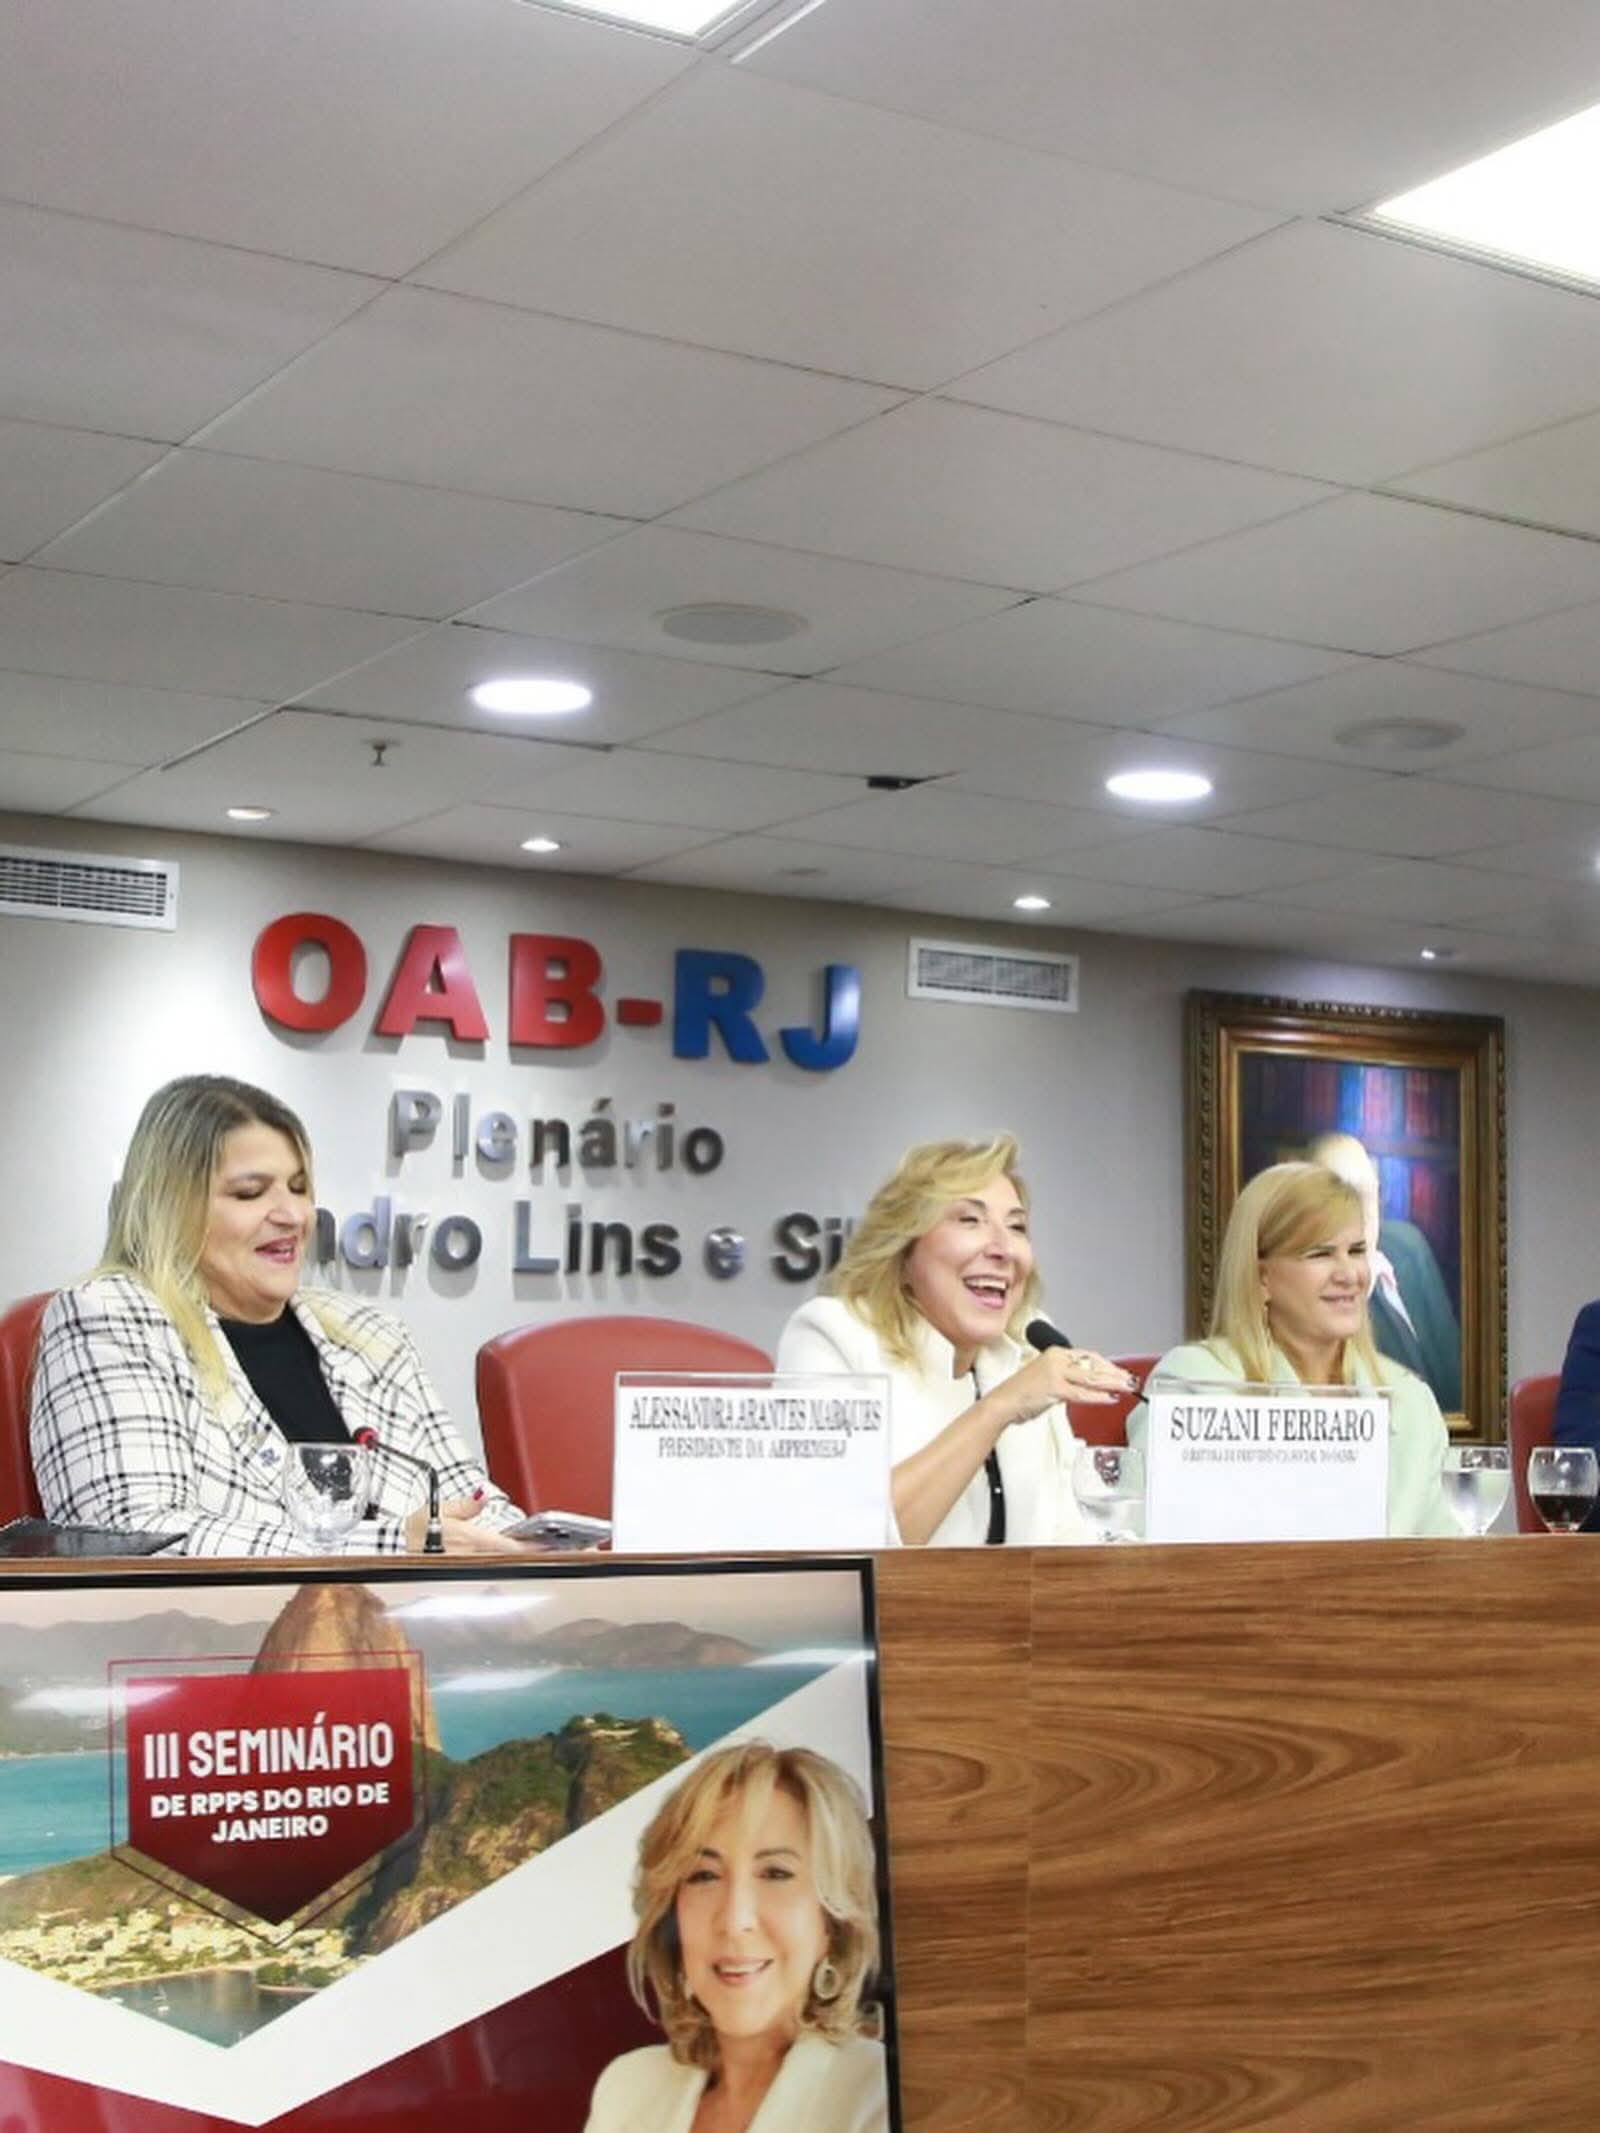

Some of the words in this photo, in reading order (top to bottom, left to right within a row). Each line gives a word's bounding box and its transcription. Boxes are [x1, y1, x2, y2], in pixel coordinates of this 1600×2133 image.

[252, 912, 862, 1071] OAB-RJ
[390, 1088, 725, 1175] Plenário
[513, 1200, 682, 1279] Lins
[704, 1226, 747, 1281] e
[629, 1396, 734, 1430] ALESSANDRA
[735, 1398, 807, 1431] ARANTES
[808, 1399, 882, 1438] MARQUES
[1170, 1406, 1260, 1442] SUZANI
[1268, 1408, 1375, 1442] FERRARO
[658, 1437, 743, 1459] PRESIDENTE
[143, 1732, 180, 1780] III
[187, 1711, 394, 1778] SEMINÁRIO
[150, 1794, 187, 1819] DE
[190, 1790, 260, 1816] RPPS
[263, 1788, 302, 1811] DO
[306, 1785, 352, 1809] RIO
[356, 1782, 390, 1805] DE
[211, 1814, 329, 1843] JANEIRO
